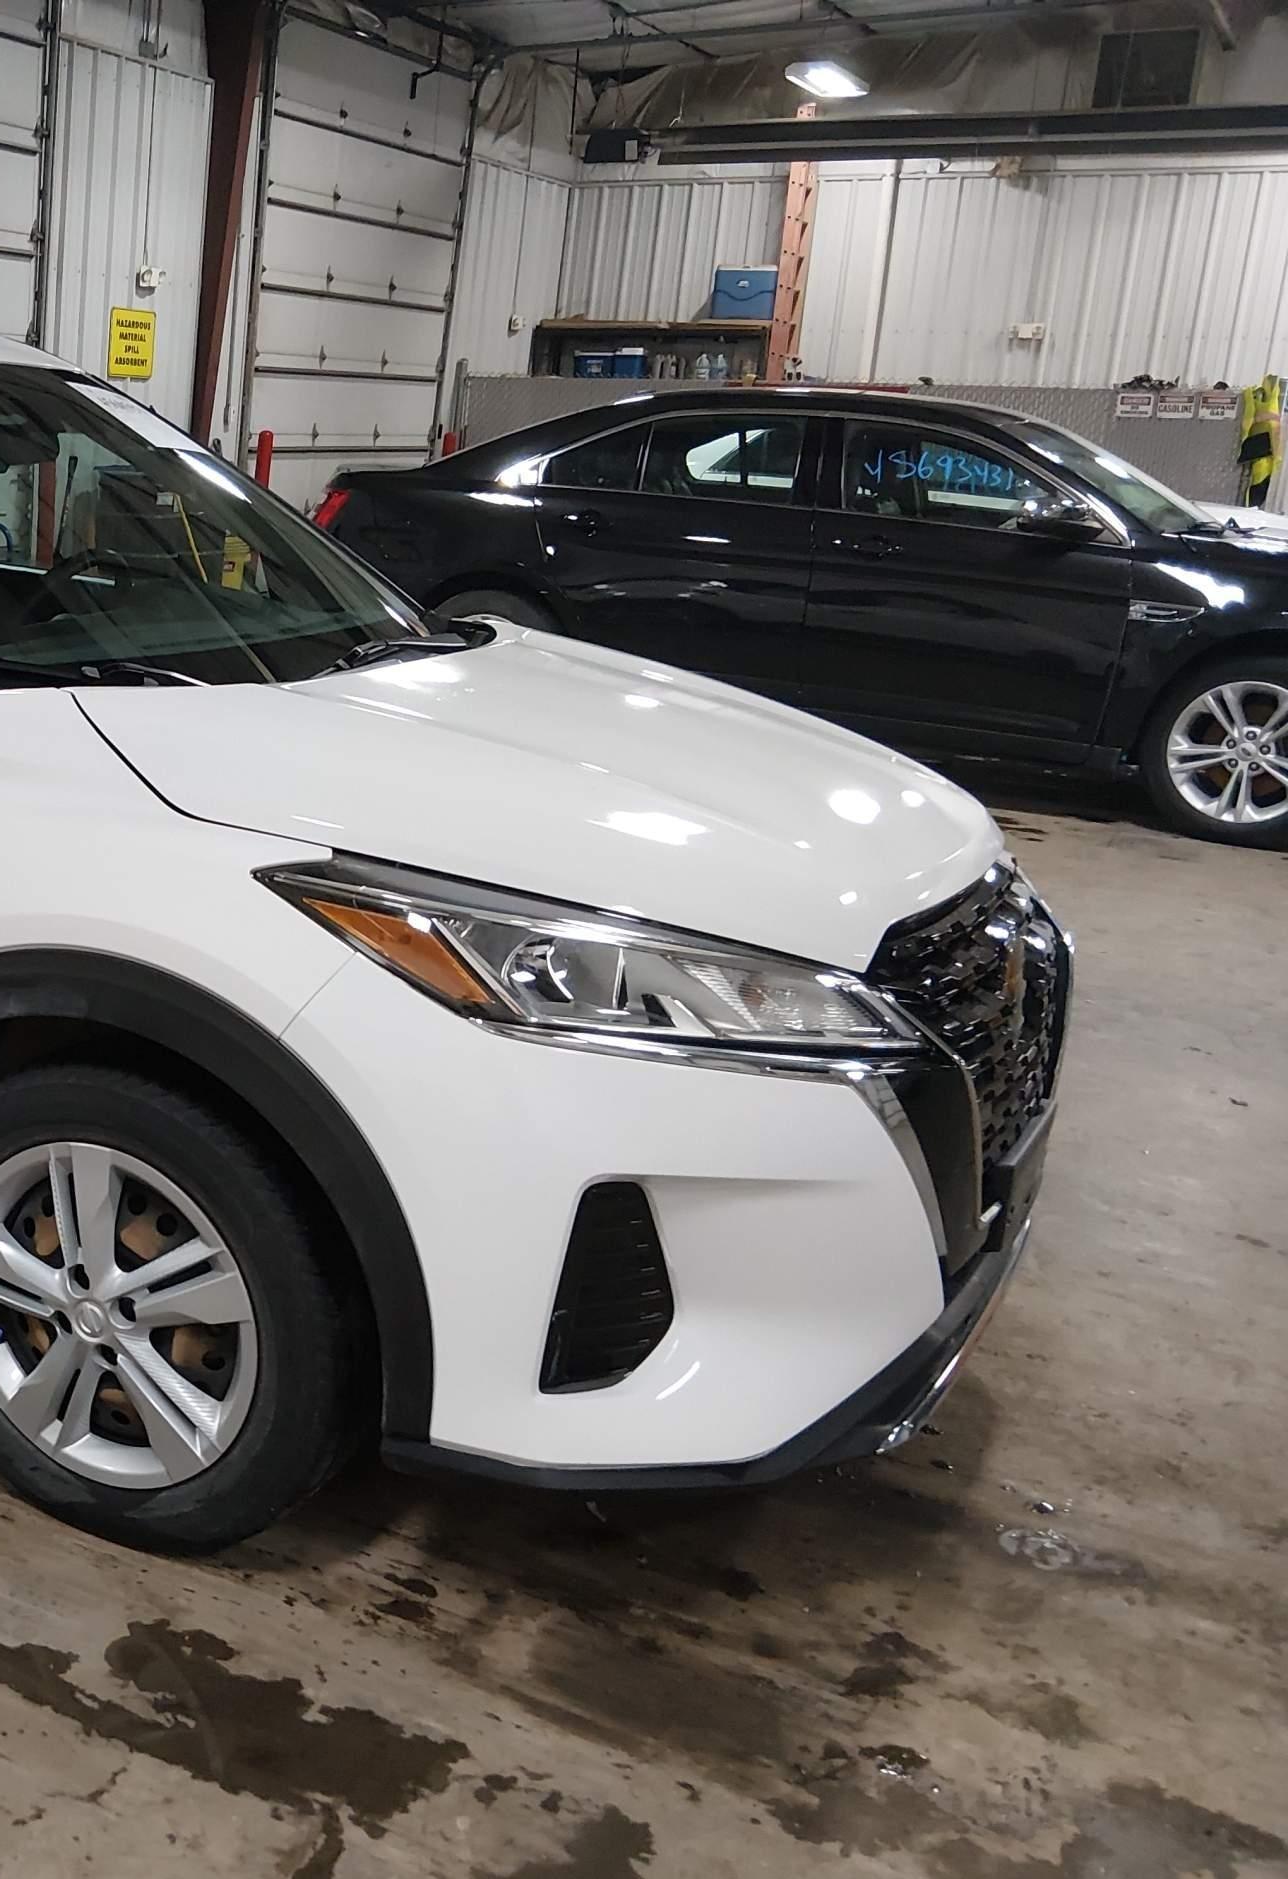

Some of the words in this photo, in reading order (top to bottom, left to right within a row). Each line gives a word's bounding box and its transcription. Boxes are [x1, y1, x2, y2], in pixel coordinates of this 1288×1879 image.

[116, 319, 151, 330] HAZARDOUS
[119, 331, 146, 342] MATERIAL
[124, 345, 139, 354] SPILL
[115, 357, 148, 367] ABSORBENT
[1158, 404, 1192, 413] GASOLINE
